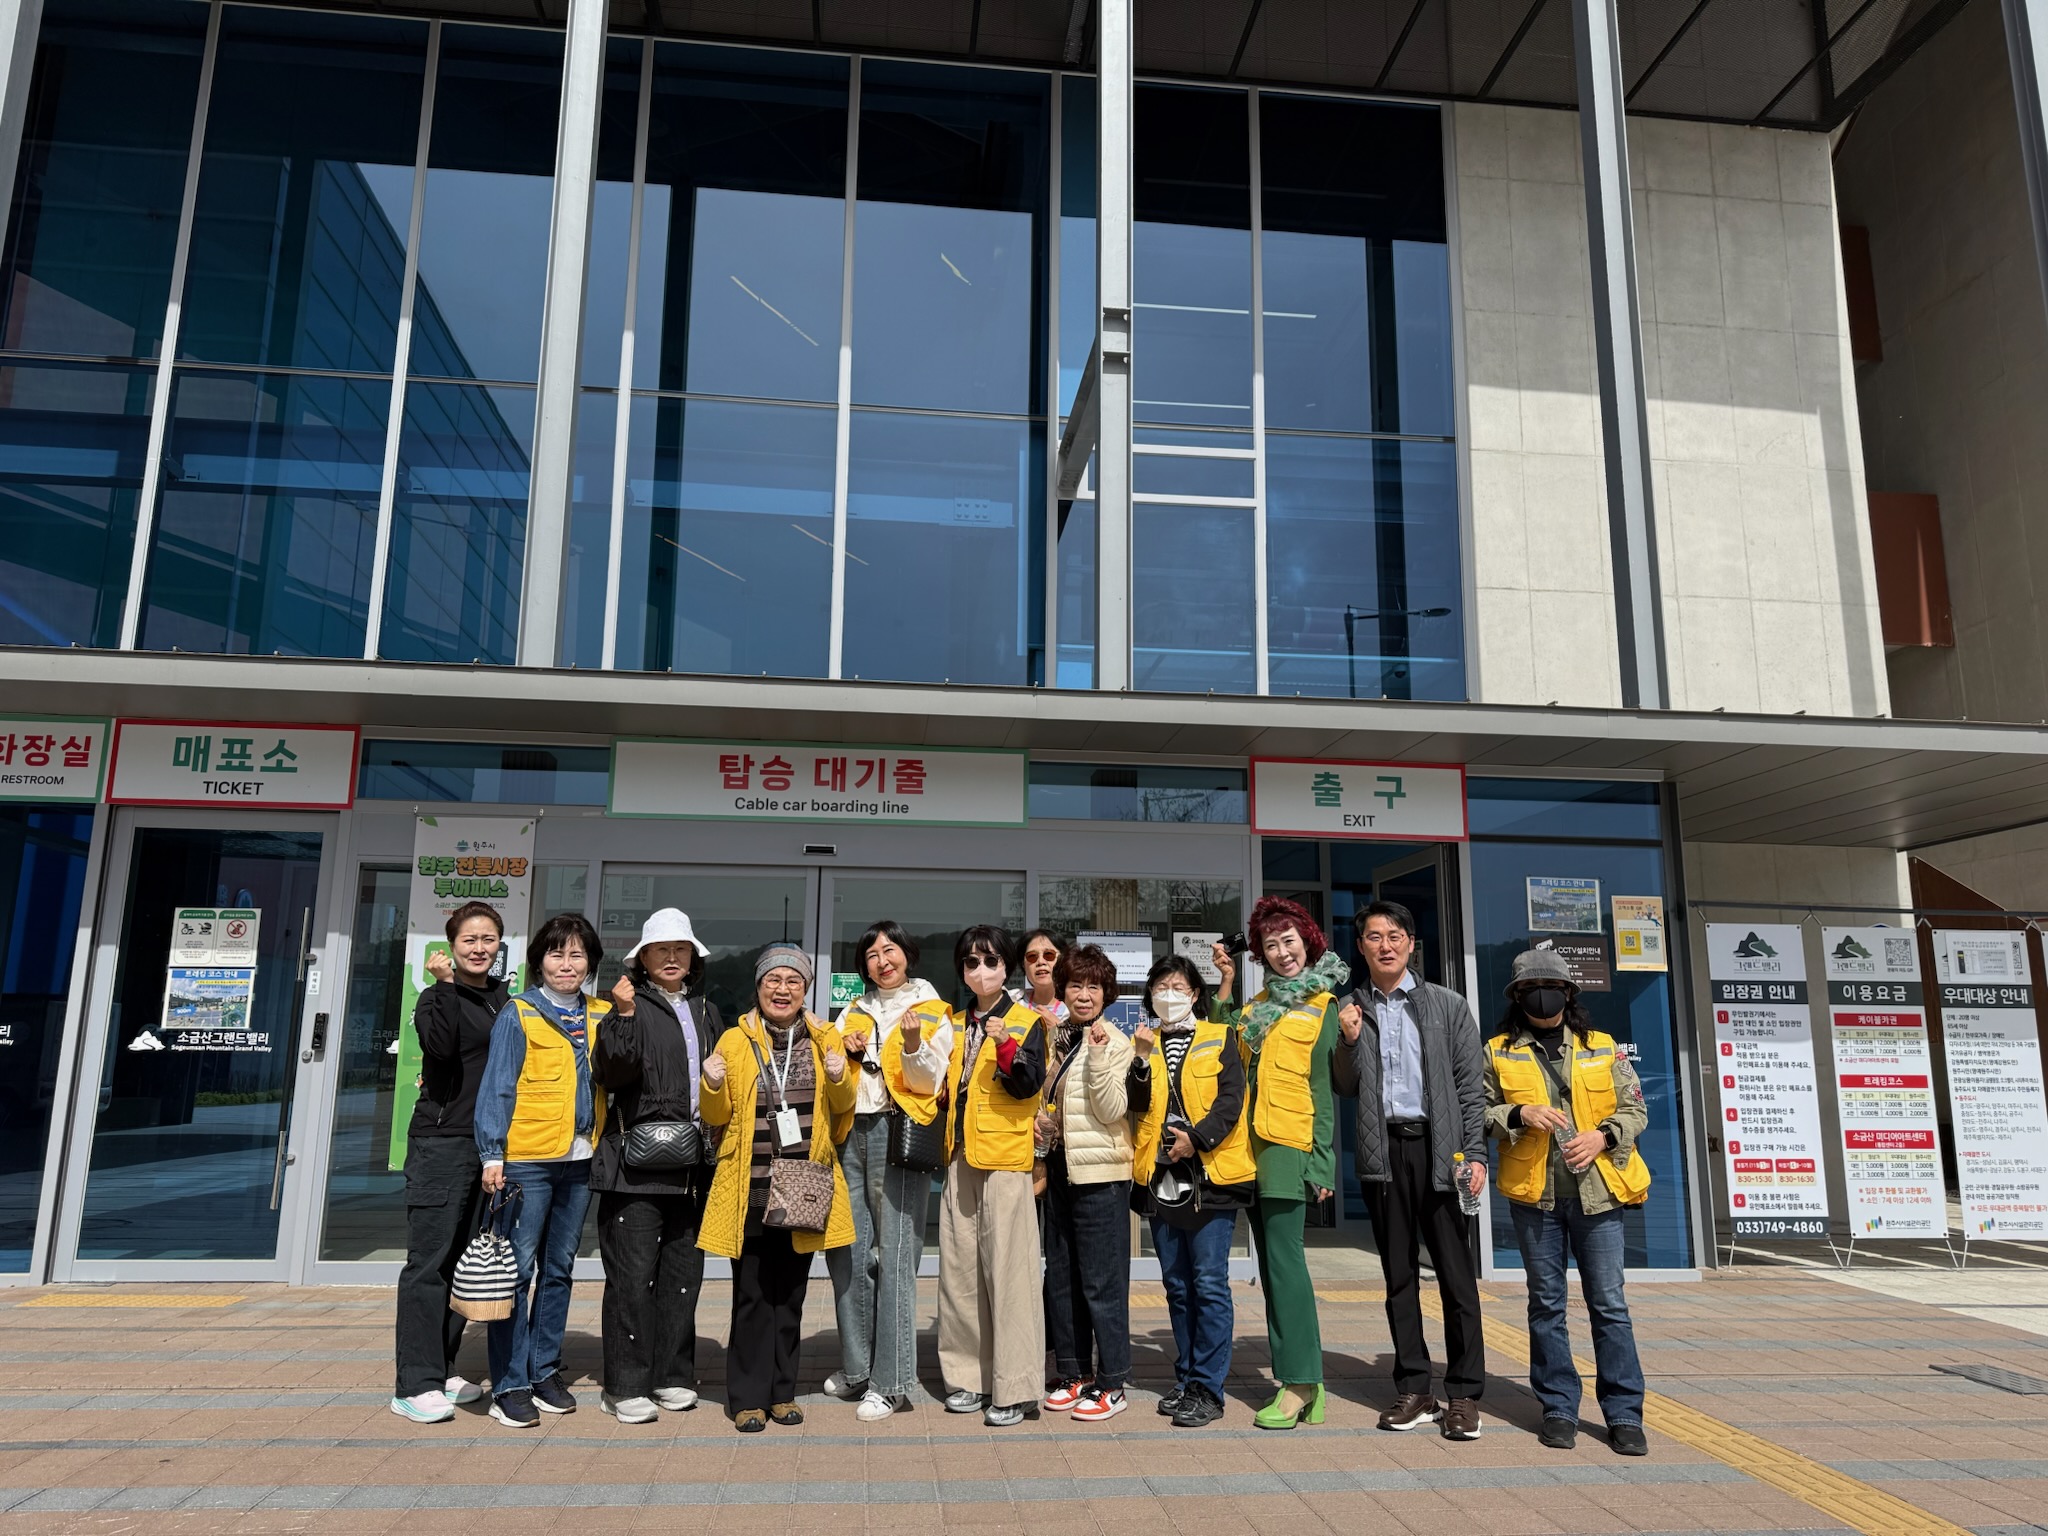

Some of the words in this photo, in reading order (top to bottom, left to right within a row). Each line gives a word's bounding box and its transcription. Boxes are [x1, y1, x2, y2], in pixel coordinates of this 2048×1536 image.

[172, 736, 297, 773] 매표소
[1, 775, 64, 785] RESTROOM
[719, 754, 794, 791] 탑승
[814, 757, 927, 794] 대기줄
[203, 781, 264, 795] TICKET
[735, 797, 779, 811] Cable
[783, 800, 807, 811] car
[811, 799, 878, 815] boarding
[883, 800, 909, 813] line
[1343, 814, 1375, 827] EXIT
[473, 841, 495, 851] 원주시
[418, 856, 455, 876] 원주
[456, 857, 528, 877] 전통시장
[1558, 946, 1601, 954] CCTV설치안내
[208, 970, 222, 978] 코스
[1722, 984, 1763, 1000] 입장권
[1768, 985, 1796, 1000] 안내
[1843, 985, 1907, 1001] 이용요금
[1944, 988, 1997, 1004] 우대대상
[2000, 989, 2028, 1005] 안내
[1858, 1016, 1897, 1025] 케이블카권
[177, 1031, 269, 1045] 소금산그랜드밸리
[171, 1044, 205, 1052] Sogeumsan
[254, 1045, 272, 1053] Valley
[1864, 1077, 1904, 1085] 트레킹코스
[1853, 1132, 1874, 1141] 소금산
[1875, 1132, 1927, 1142] 미디어아트센터
[1738, 1175, 1772, 1183] 8:30~15:30
[1780, 1175, 1814, 1183] 8:30~16:30
[1737, 1221, 1823, 1233] 033)749-4860
